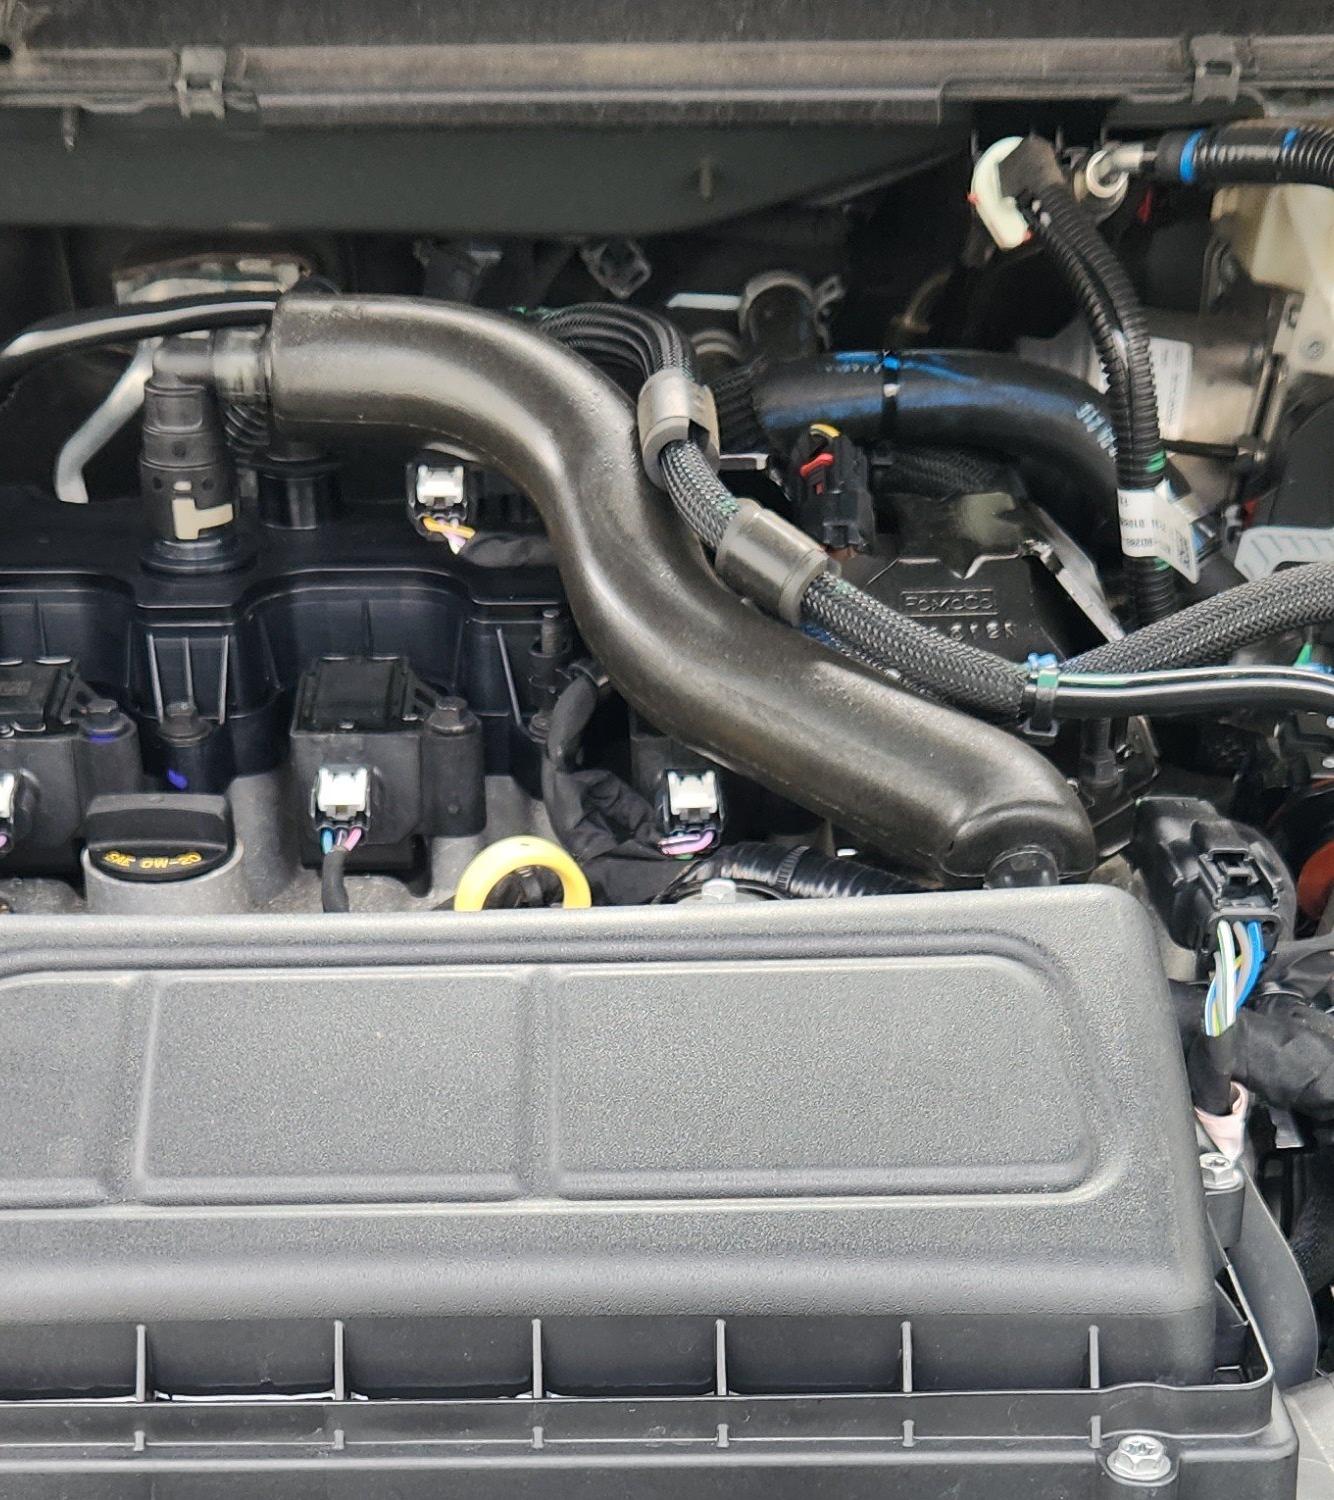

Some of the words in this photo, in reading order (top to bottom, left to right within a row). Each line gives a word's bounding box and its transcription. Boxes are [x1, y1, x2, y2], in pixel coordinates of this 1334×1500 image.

[904, 594, 995, 612] FoMoCo
[101, 851, 137, 869] SAE
[140, 852, 202, 869] 0W-20
